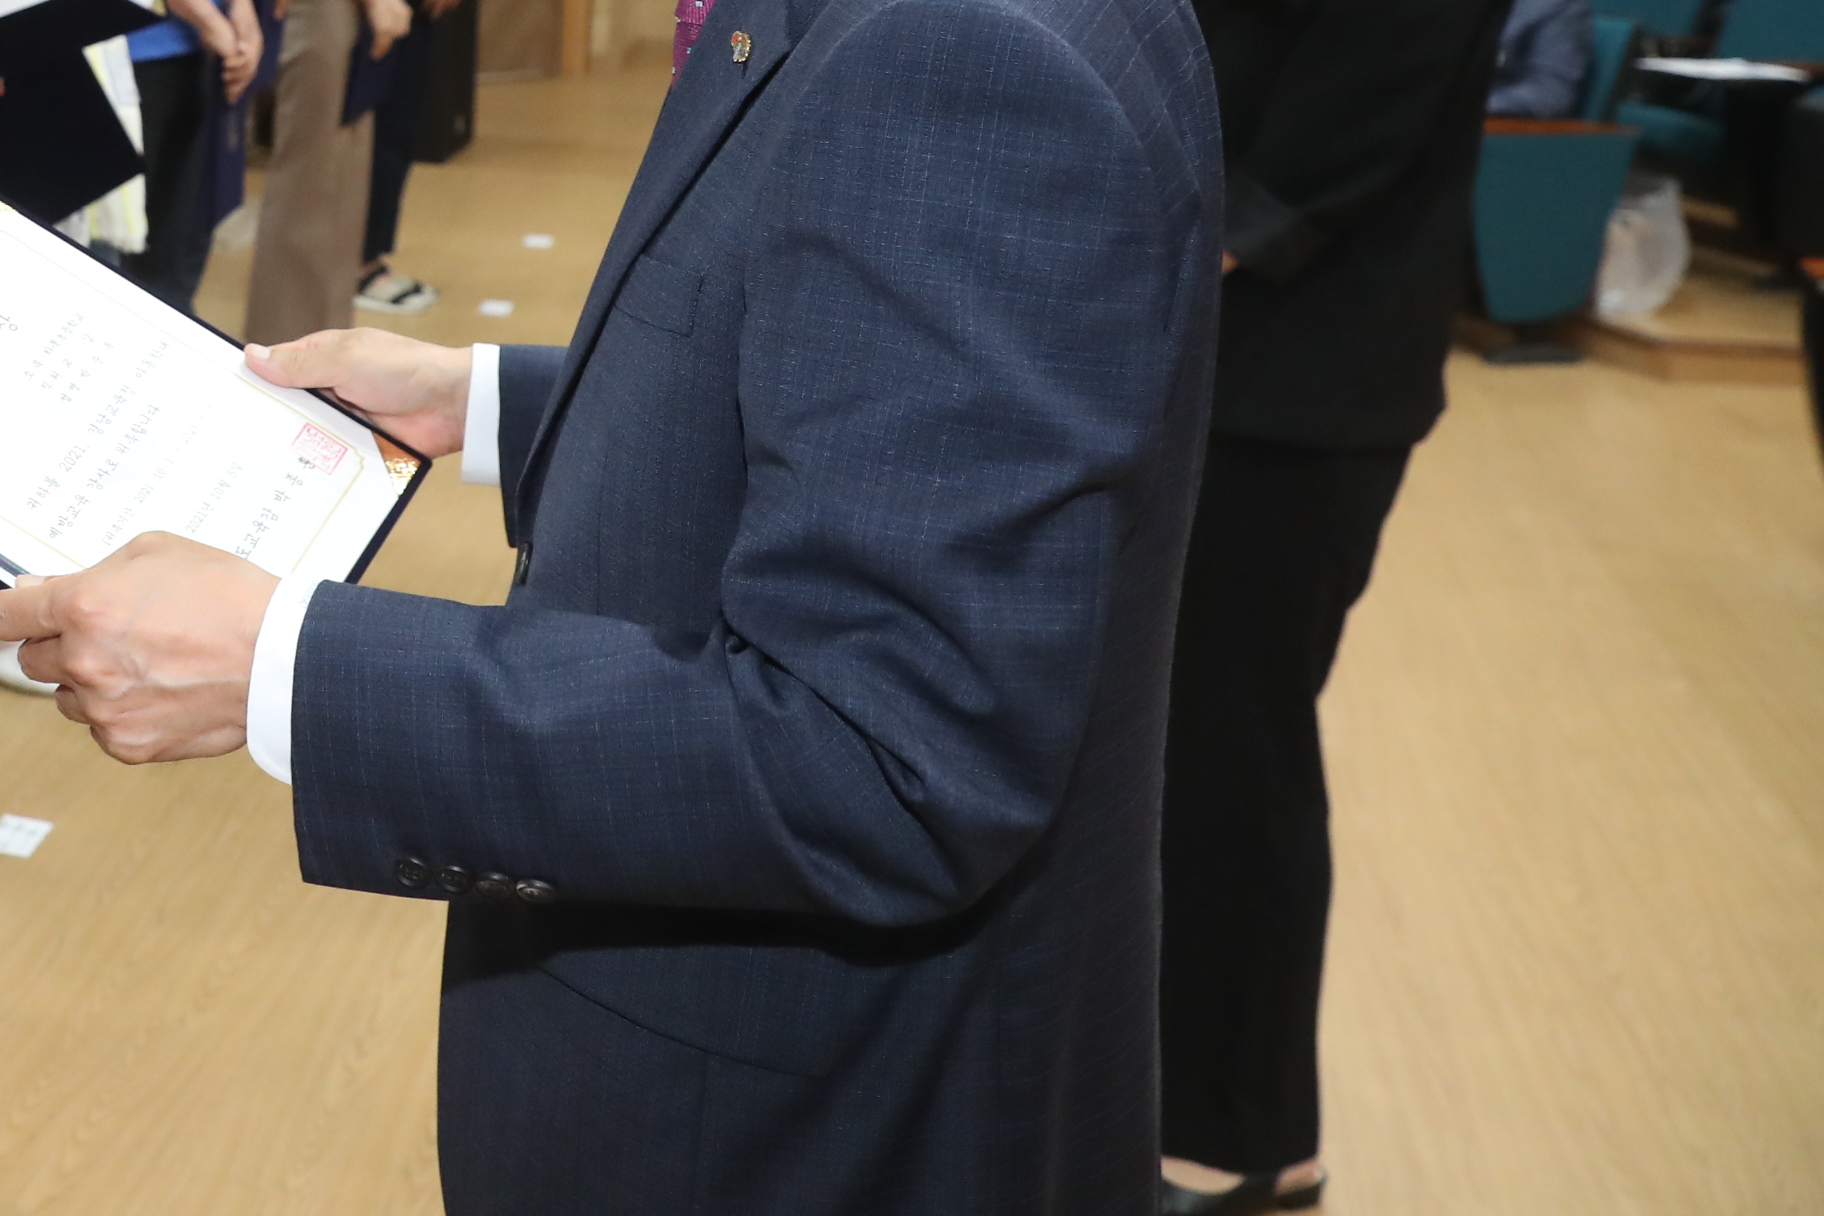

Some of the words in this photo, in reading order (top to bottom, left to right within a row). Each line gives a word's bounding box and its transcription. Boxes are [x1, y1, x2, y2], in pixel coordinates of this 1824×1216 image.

[48, 493, 91, 539] 예방교육
[85, 457, 120, 490] 강사로
[114, 403, 161, 455] 위촉합니다
